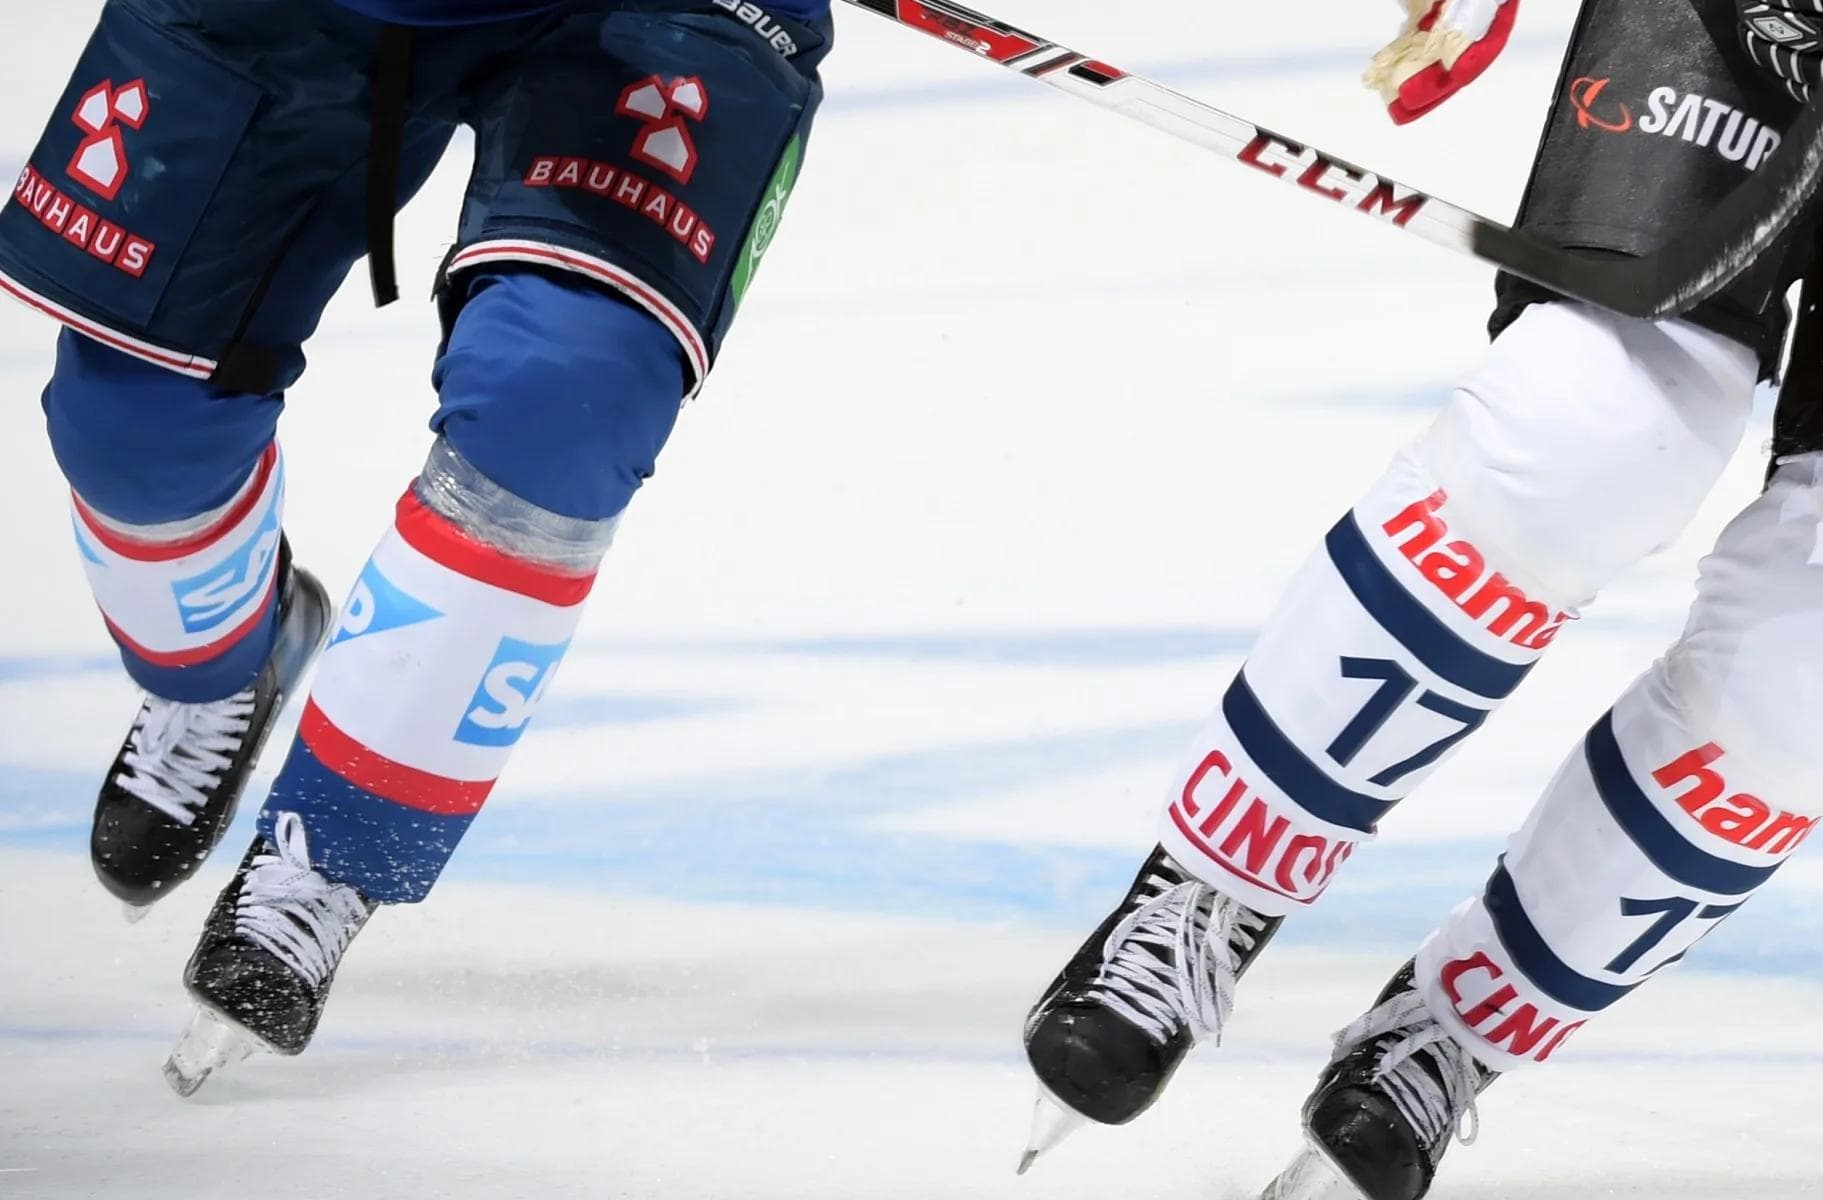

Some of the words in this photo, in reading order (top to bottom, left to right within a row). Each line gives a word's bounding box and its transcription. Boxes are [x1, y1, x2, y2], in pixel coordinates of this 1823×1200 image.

[16, 166, 151, 272] BAUHAUS
[531, 158, 713, 258] BAUHAUS
[1238, 126, 1432, 230] CCM
[1325, 655, 1492, 788] 17
